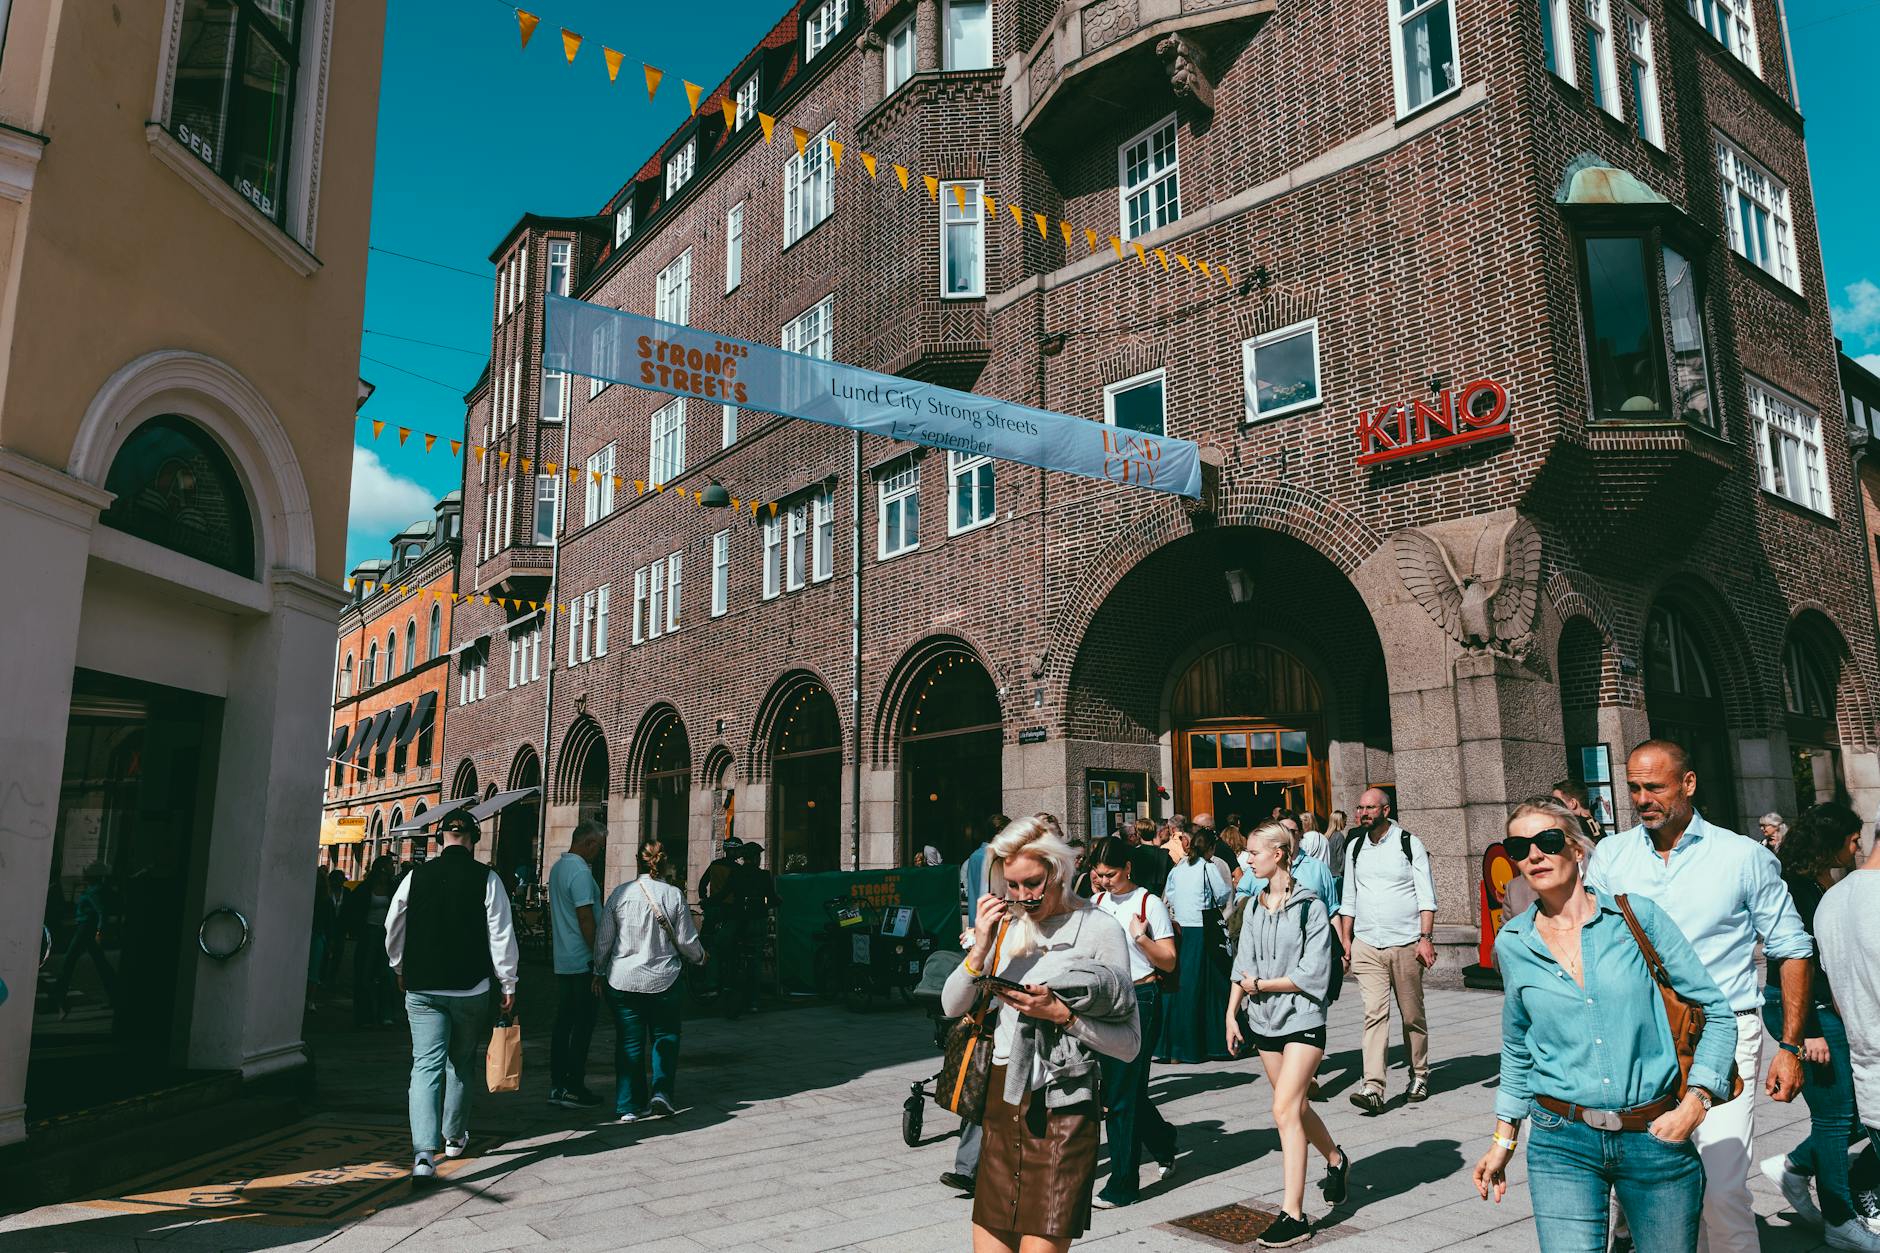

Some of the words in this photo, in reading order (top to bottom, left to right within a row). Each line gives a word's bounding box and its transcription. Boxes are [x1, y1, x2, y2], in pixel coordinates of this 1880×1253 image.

[178, 124, 213, 163] SEB
[241, 179, 271, 213] SEB
[637, 335, 737, 379] STRONG
[715, 340, 748, 359] 2025
[640, 360, 748, 403] STREETS
[831, 378, 878, 404] Lund
[885, 389, 922, 415] City
[927, 396, 982, 430] Strong
[986, 410, 1039, 436] Streets
[920, 428, 992, 453] september
[1102, 430, 1161, 461] LUND
[1104, 457, 1160, 486] CITY
[851, 882, 896, 897] STRONG
[851, 894, 901, 909] REETS
